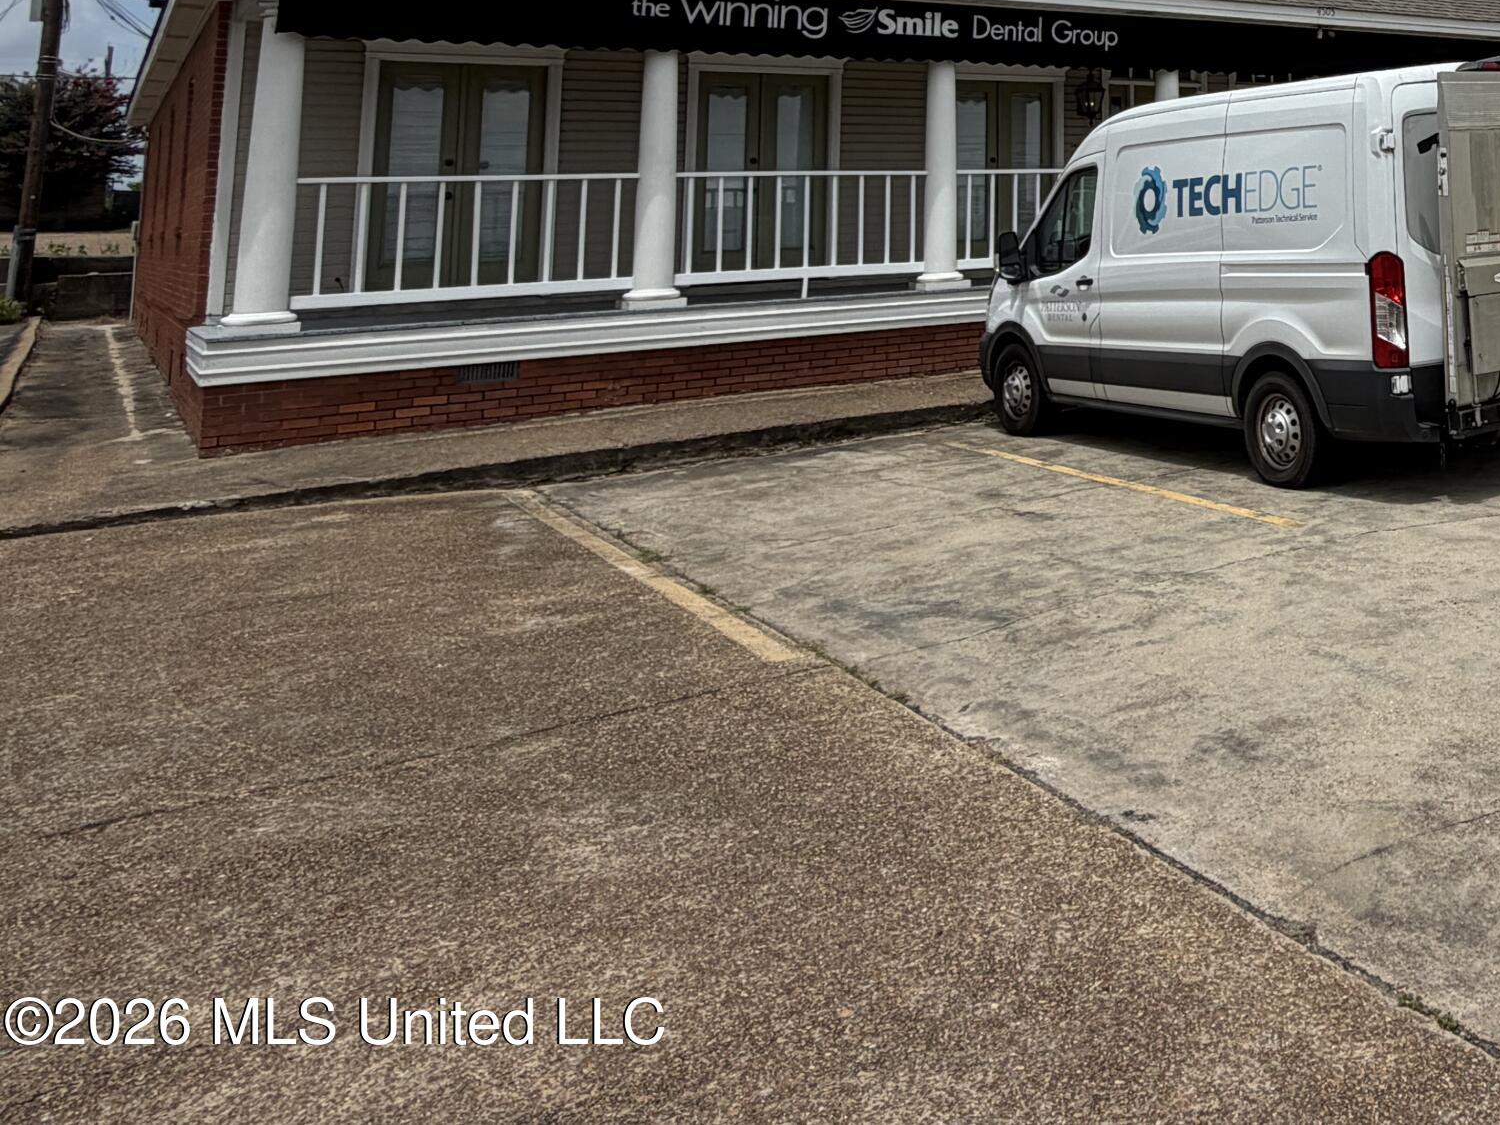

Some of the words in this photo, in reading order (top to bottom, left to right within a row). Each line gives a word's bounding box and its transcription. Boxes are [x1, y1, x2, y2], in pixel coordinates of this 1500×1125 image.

[877, 9, 959, 38] Smile
[972, 14, 1043, 42] Dental
[1051, 20, 1118, 51] Group
